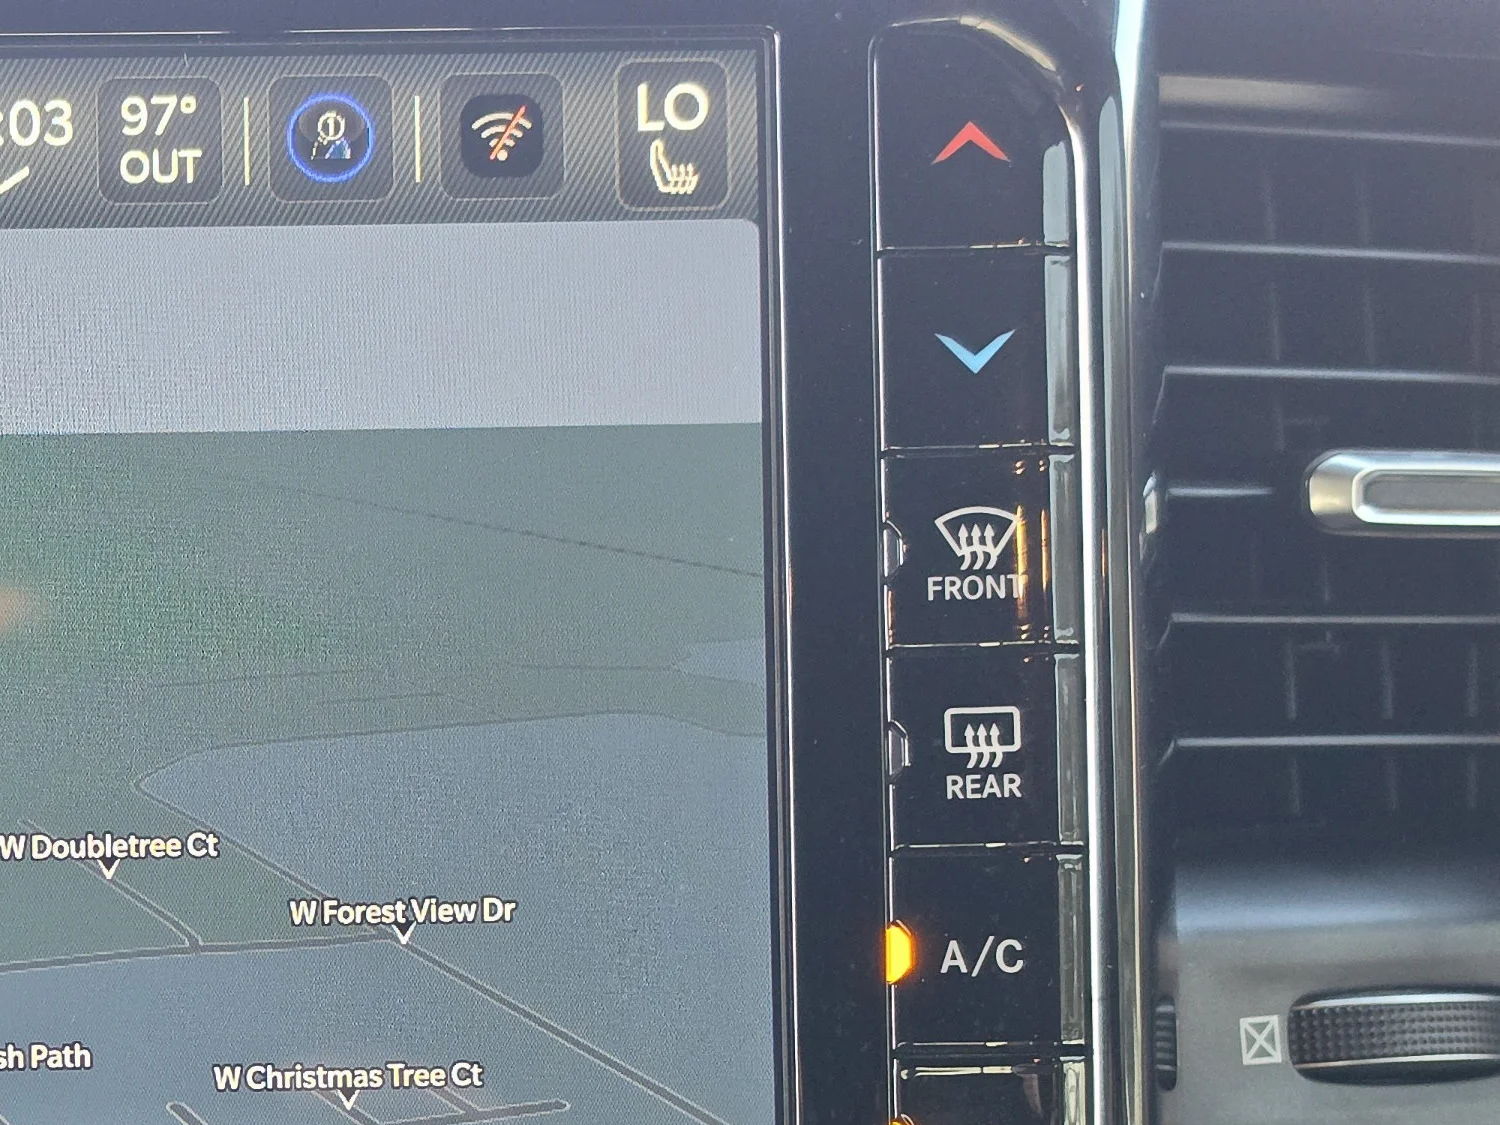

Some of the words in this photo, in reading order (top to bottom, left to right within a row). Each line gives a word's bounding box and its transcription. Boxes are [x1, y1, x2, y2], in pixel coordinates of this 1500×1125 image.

[637, 82, 710, 132] LO
[119, 148, 203, 185] OUT
[926, 575, 1026, 602] FRONT
[945, 774, 1023, 800] REAR
[31, 832, 181, 860] Doubletree
[187, 832, 219, 858] Ct
[290, 900, 318, 925] W
[323, 899, 406, 925] Forest
[410, 898, 476, 924] View
[481, 898, 516, 923] Dr
[940, 935, 1025, 975] A/C
[30, 1043, 92, 1068] Path
[213, 1066, 242, 1091] W
[245, 1064, 383, 1090] Christmas
[387, 1063, 446, 1088] Tree
[451, 1062, 483, 1088] Ct
